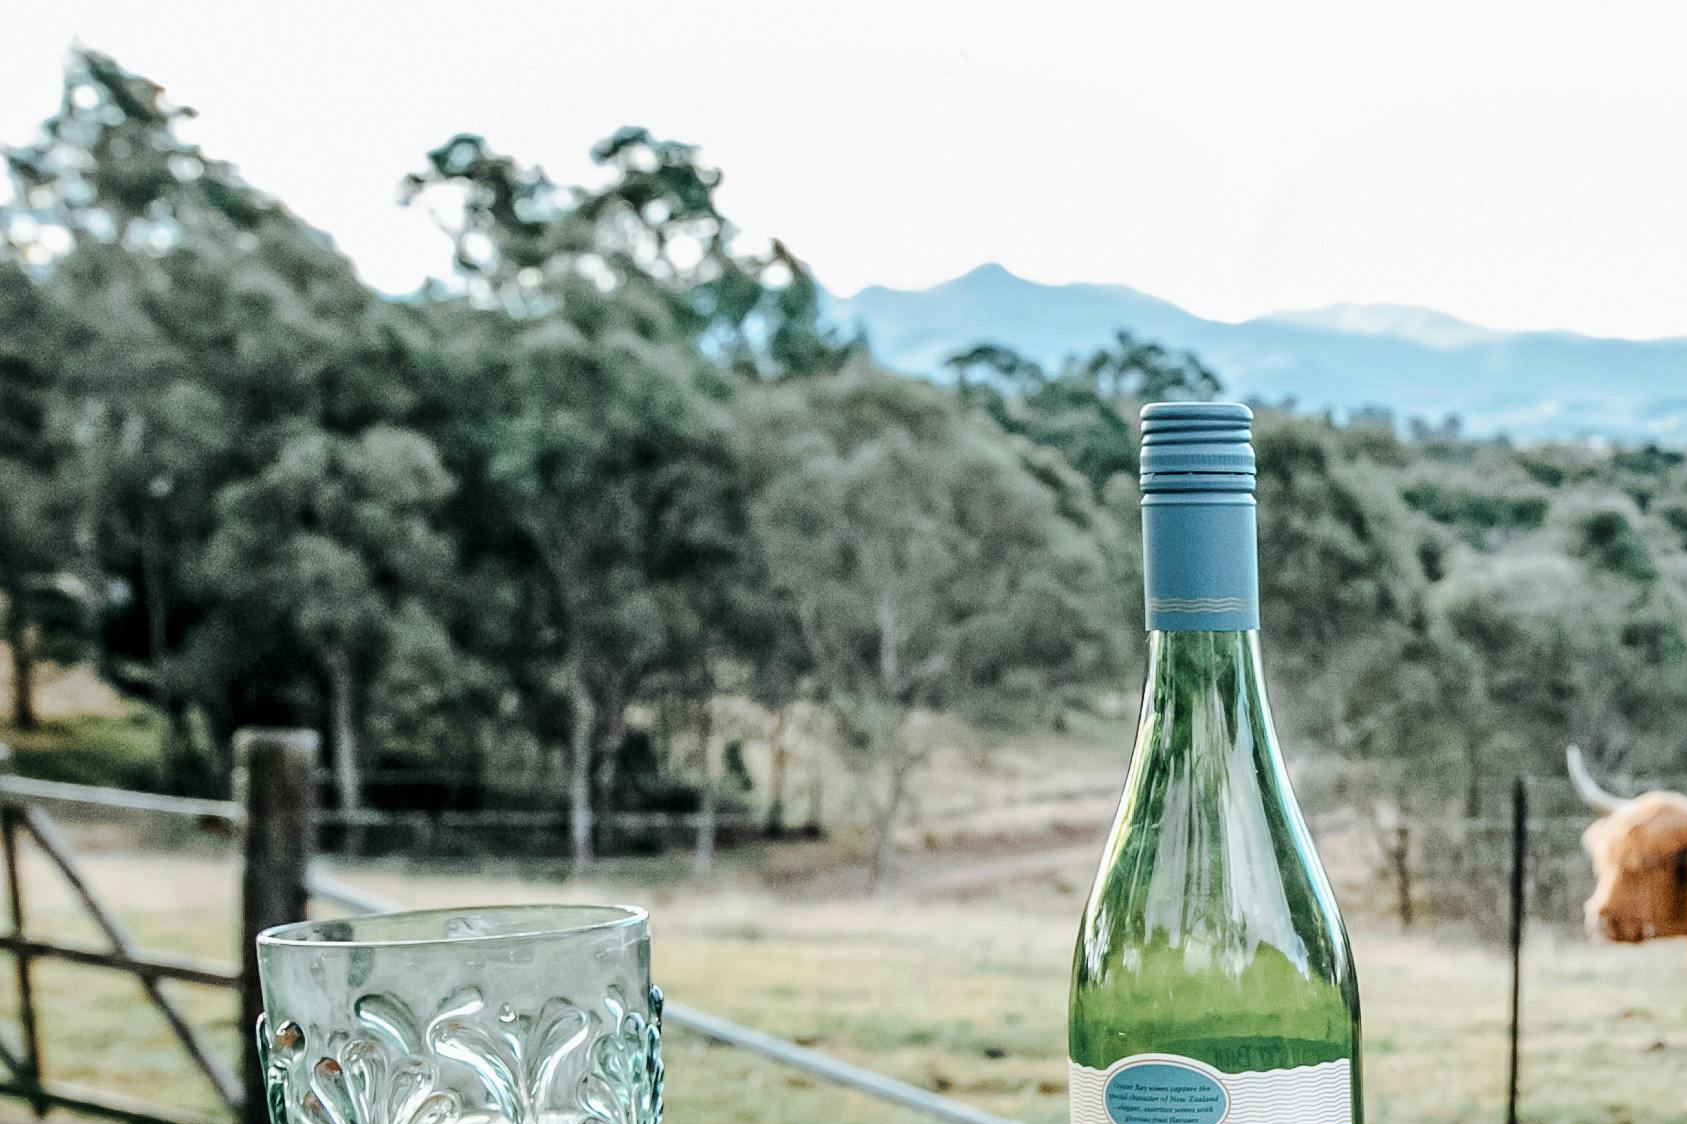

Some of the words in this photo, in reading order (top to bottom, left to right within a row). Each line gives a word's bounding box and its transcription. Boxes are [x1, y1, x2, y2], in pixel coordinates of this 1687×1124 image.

[1199, 1084, 1211, 1092] the
[1170, 1095, 1187, 1103] New
[1188, 1094, 1219, 1102] Zealand
